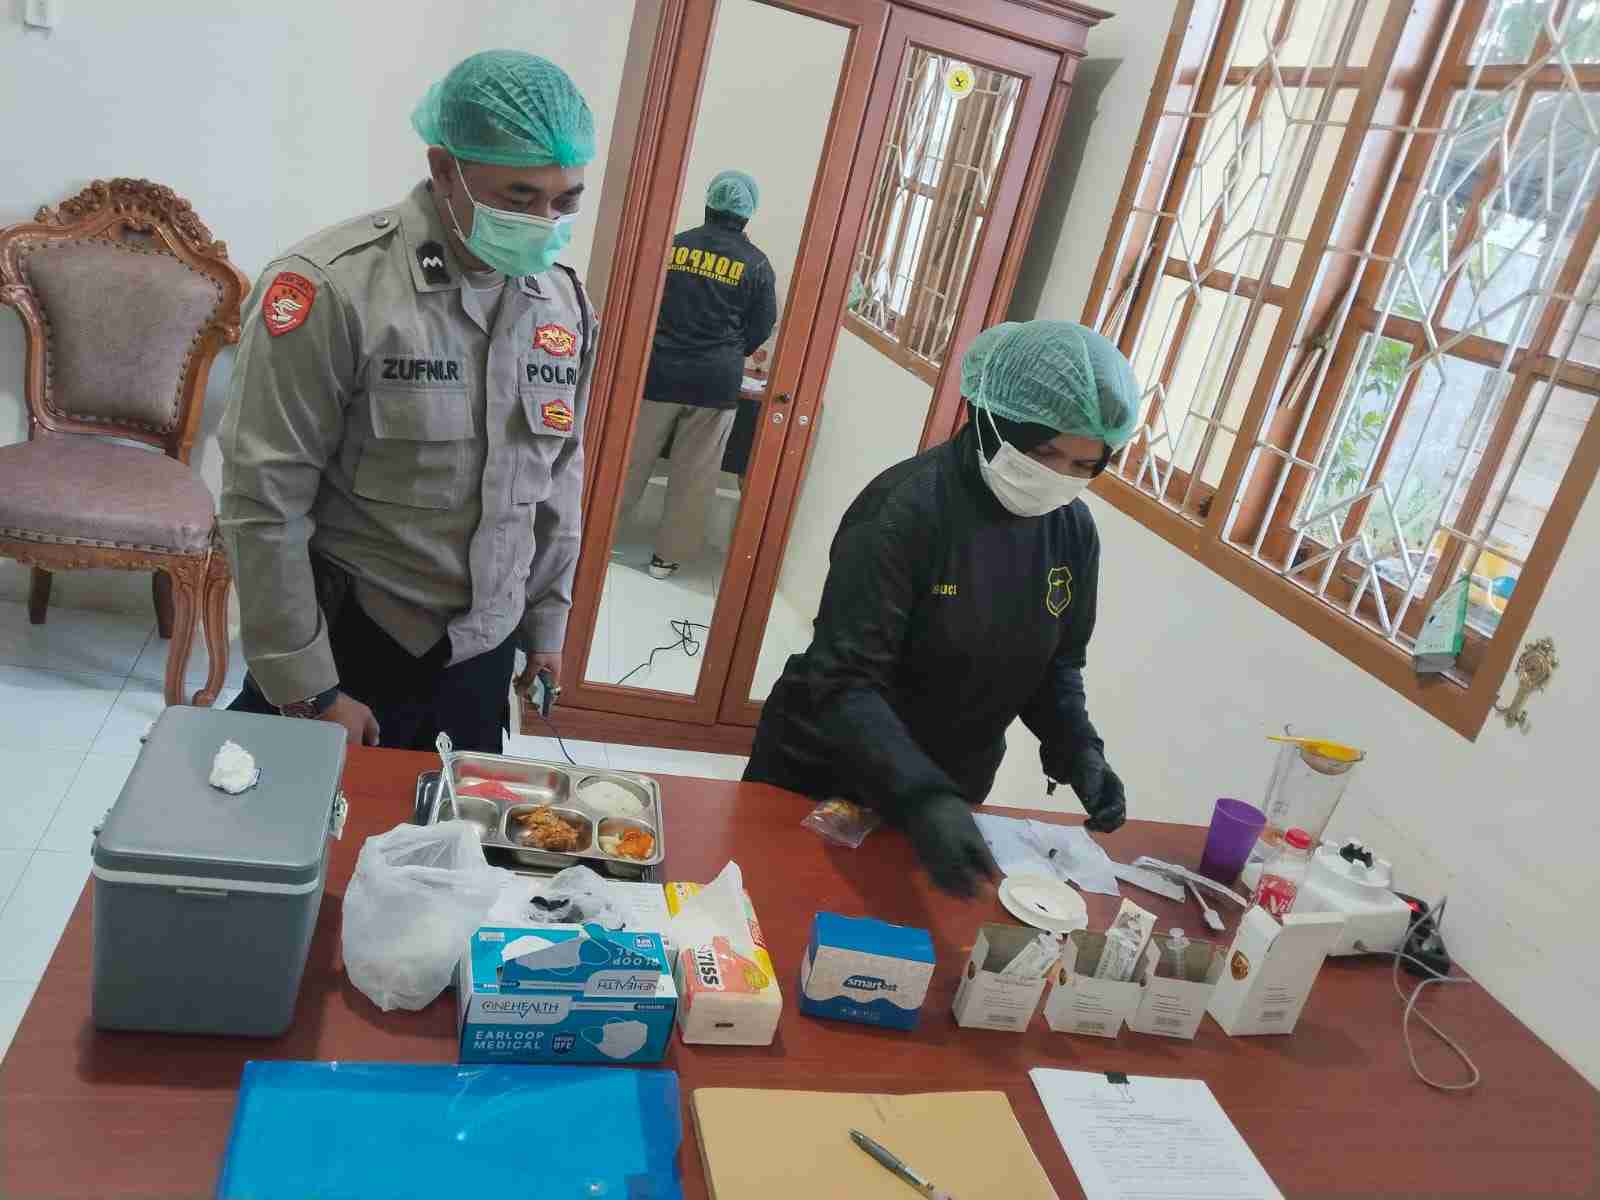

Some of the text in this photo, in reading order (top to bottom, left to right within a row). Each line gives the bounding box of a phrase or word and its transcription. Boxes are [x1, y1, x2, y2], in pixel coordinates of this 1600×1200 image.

[481, 1000, 560, 1017] ONEHEALTH
[475, 1031, 545, 1040] EARLOOP
[473, 1040, 542, 1049] MEDICAL
